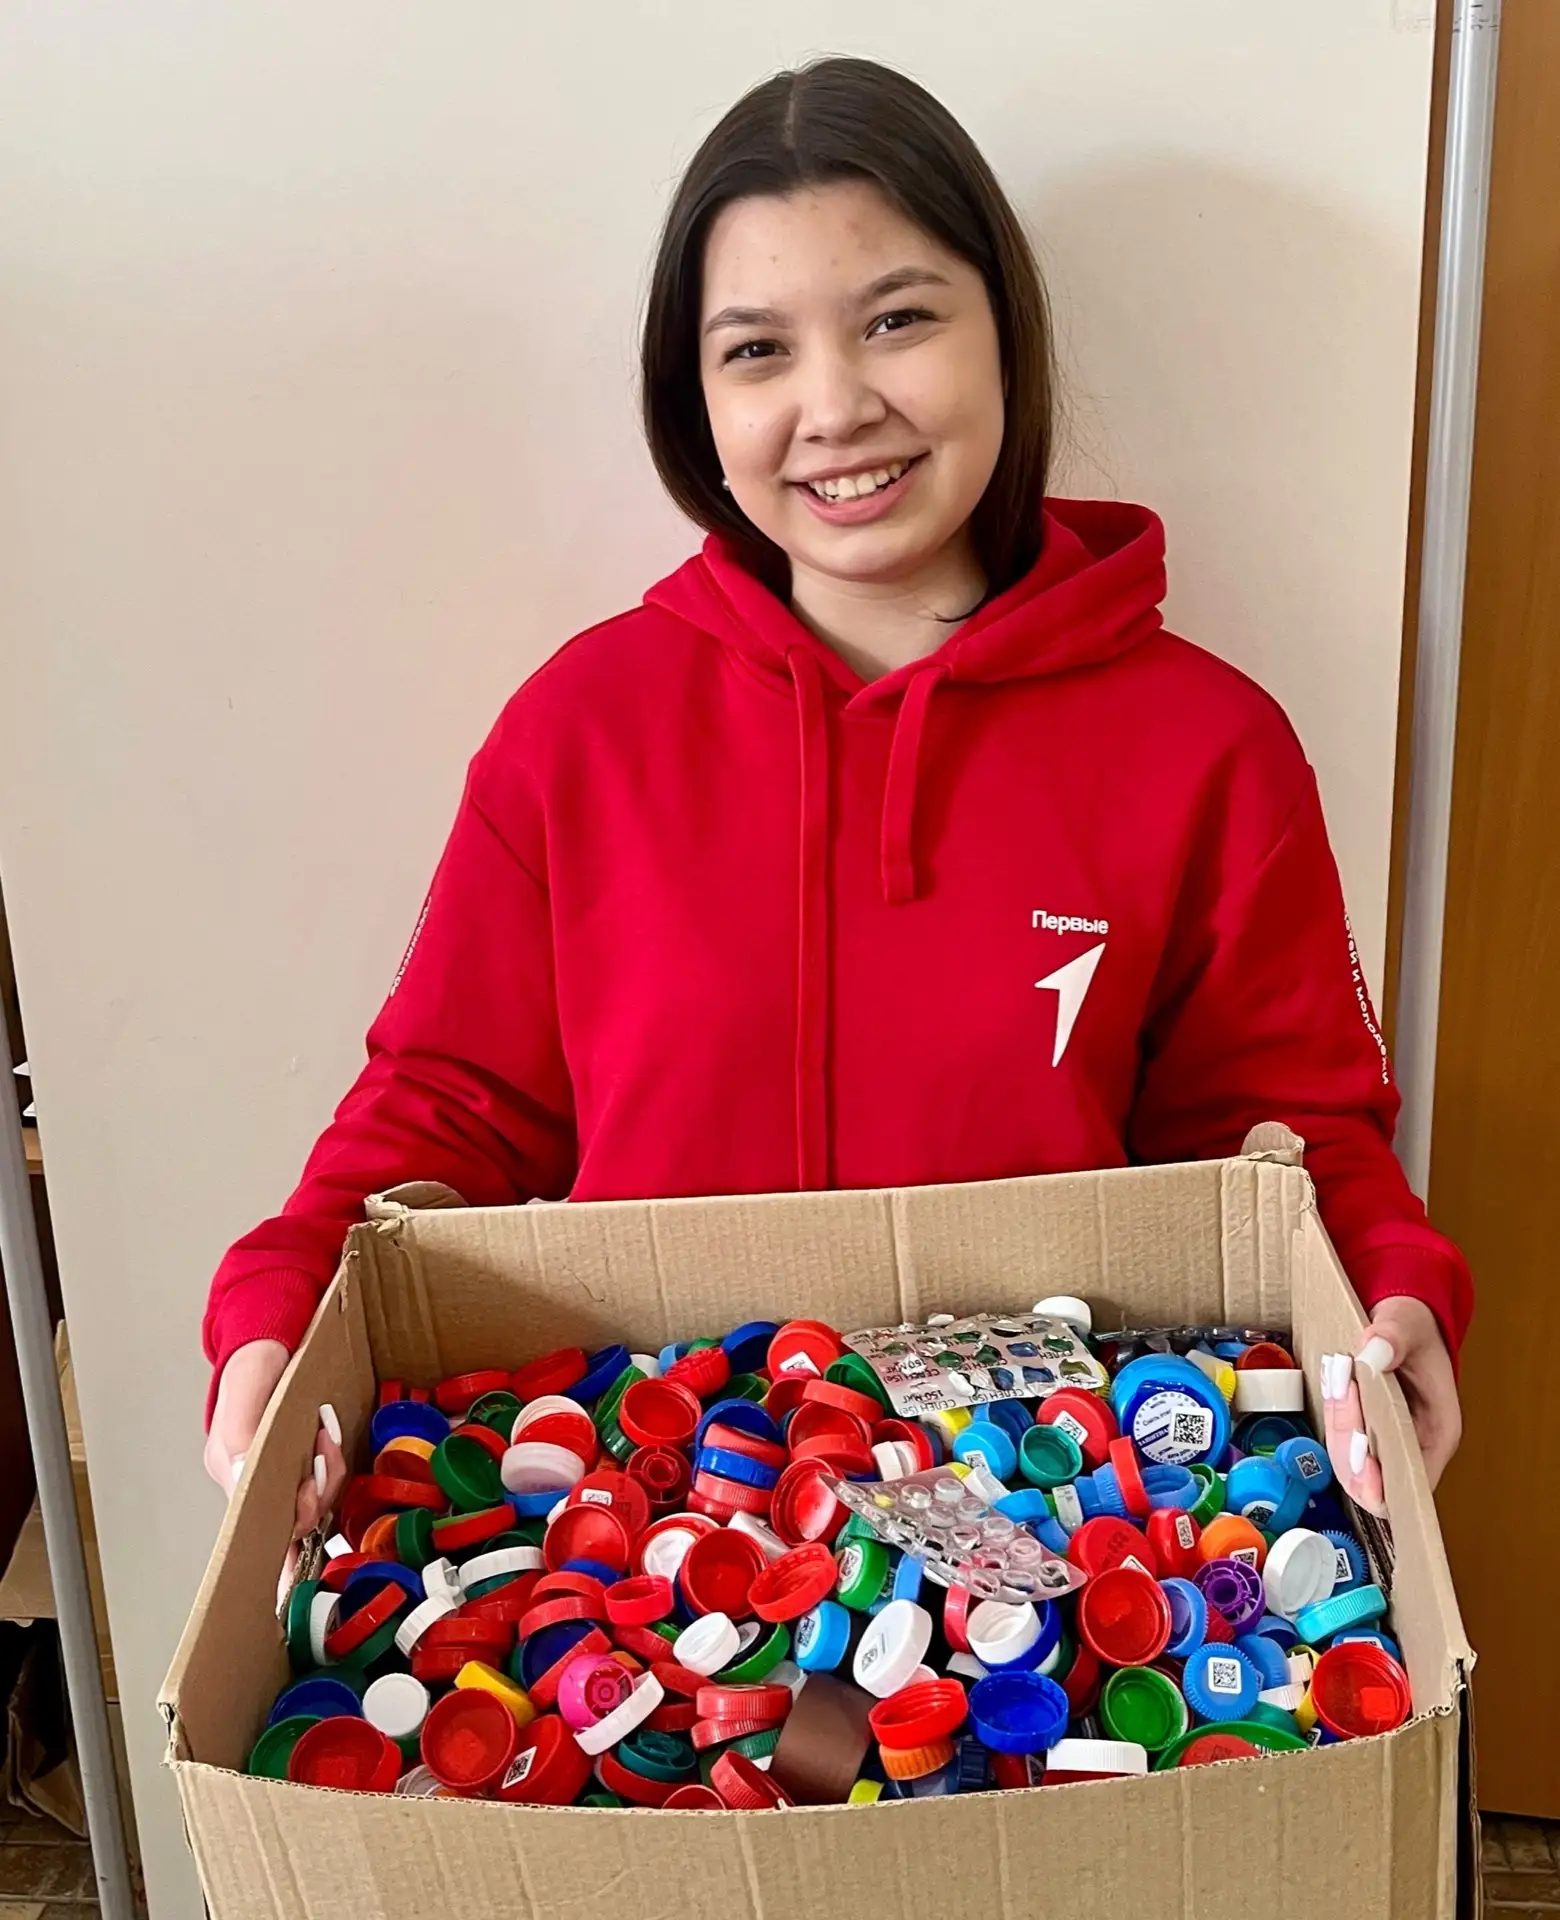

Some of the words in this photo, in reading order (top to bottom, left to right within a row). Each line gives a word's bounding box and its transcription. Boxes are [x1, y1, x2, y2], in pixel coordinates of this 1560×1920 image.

[1032, 910, 1109, 936] Первые
[1352, 969, 1361, 982] и
[1356, 986, 1389, 1085] молодежи
[990, 1388, 1024, 1400] СЕЛЕН
[920, 1399, 957, 1412] СЕЛЕН
